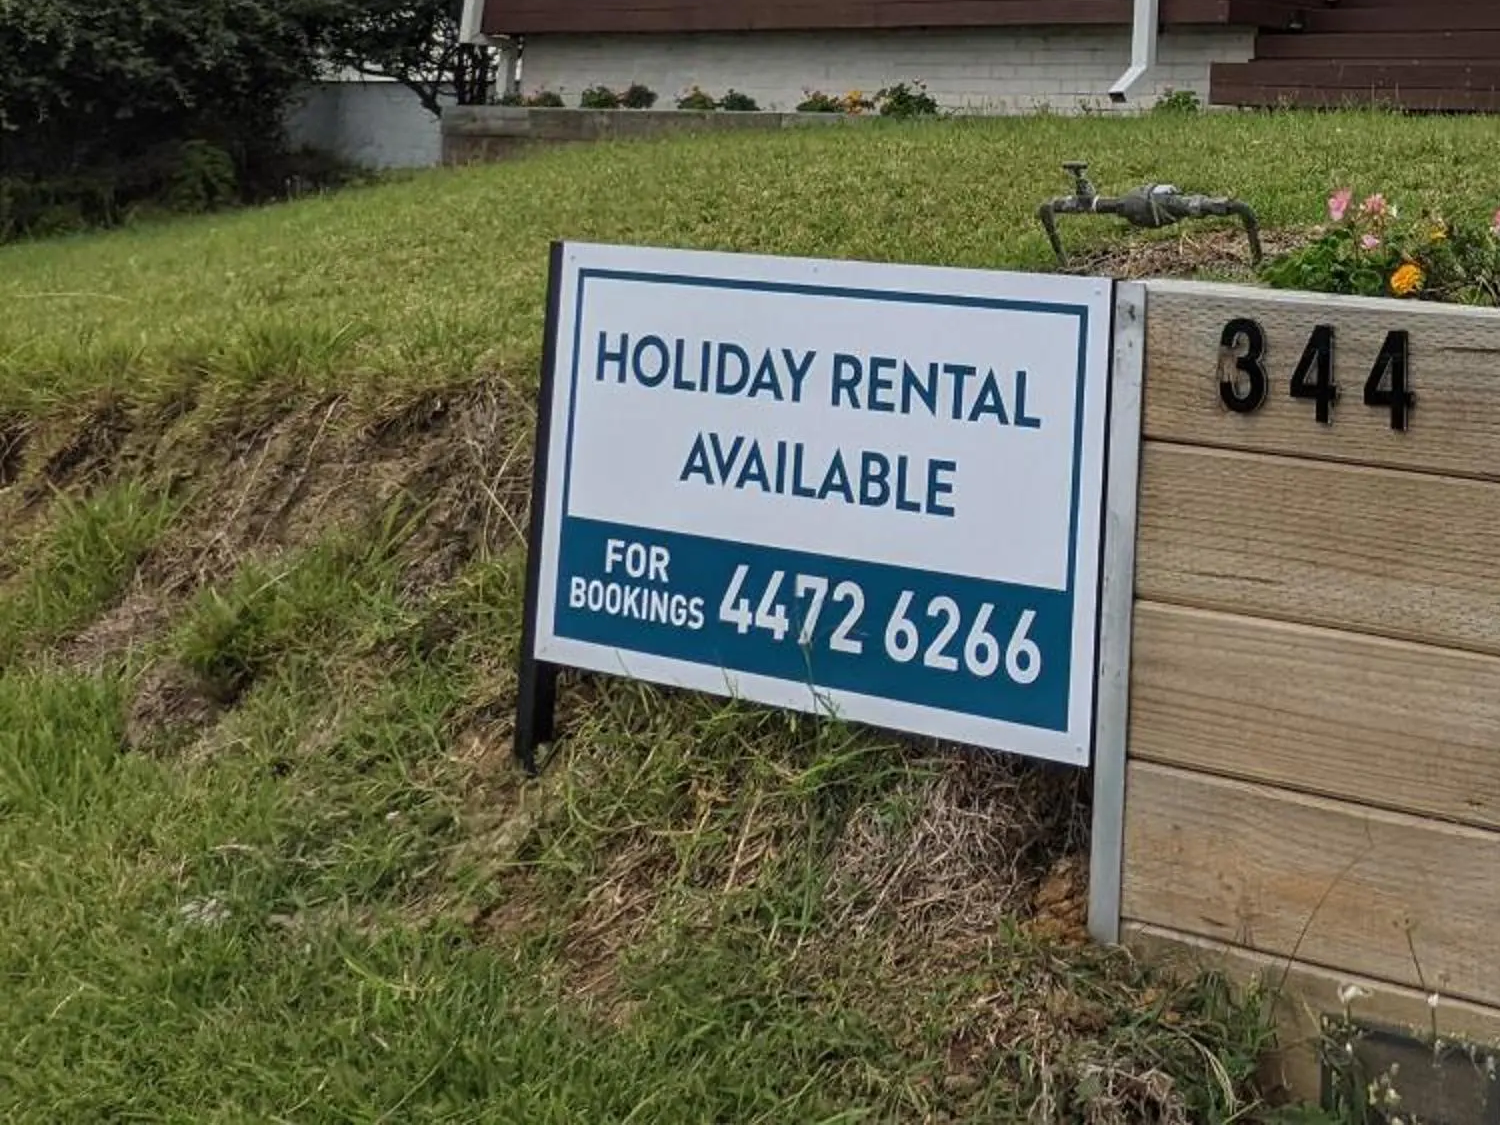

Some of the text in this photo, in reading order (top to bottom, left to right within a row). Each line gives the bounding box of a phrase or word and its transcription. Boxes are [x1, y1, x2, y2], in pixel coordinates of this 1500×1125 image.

[595, 331, 1042, 428] HOLIDAY RENTAL
[1219, 317, 1416, 432] 344
[679, 432, 957, 517] AVAILABLE
[569, 576, 705, 630] BOOKINGS
[605, 538, 671, 583] FOR
[719, 564, 1042, 685] 4472 6266
